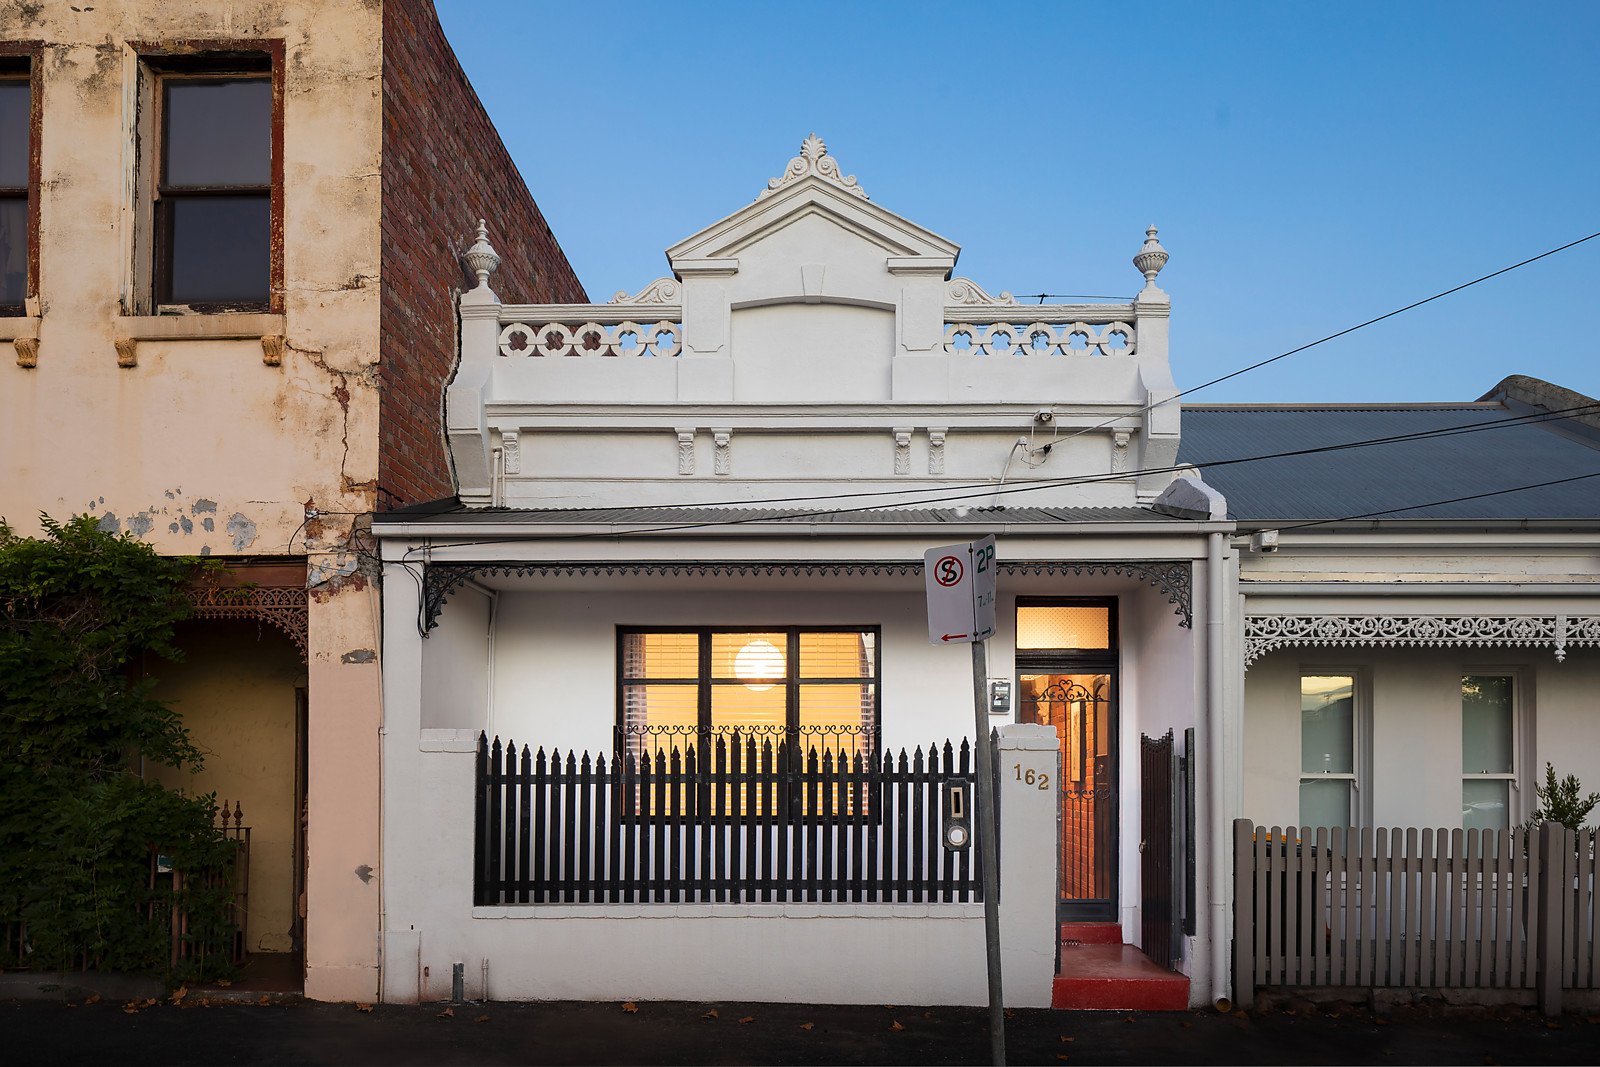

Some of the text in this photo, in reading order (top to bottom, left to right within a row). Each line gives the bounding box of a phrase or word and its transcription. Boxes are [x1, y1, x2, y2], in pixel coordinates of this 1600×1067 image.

[941, 560, 957, 582] S
[976, 544, 994, 574] 2P
[1013, 763, 1049, 790] 162
